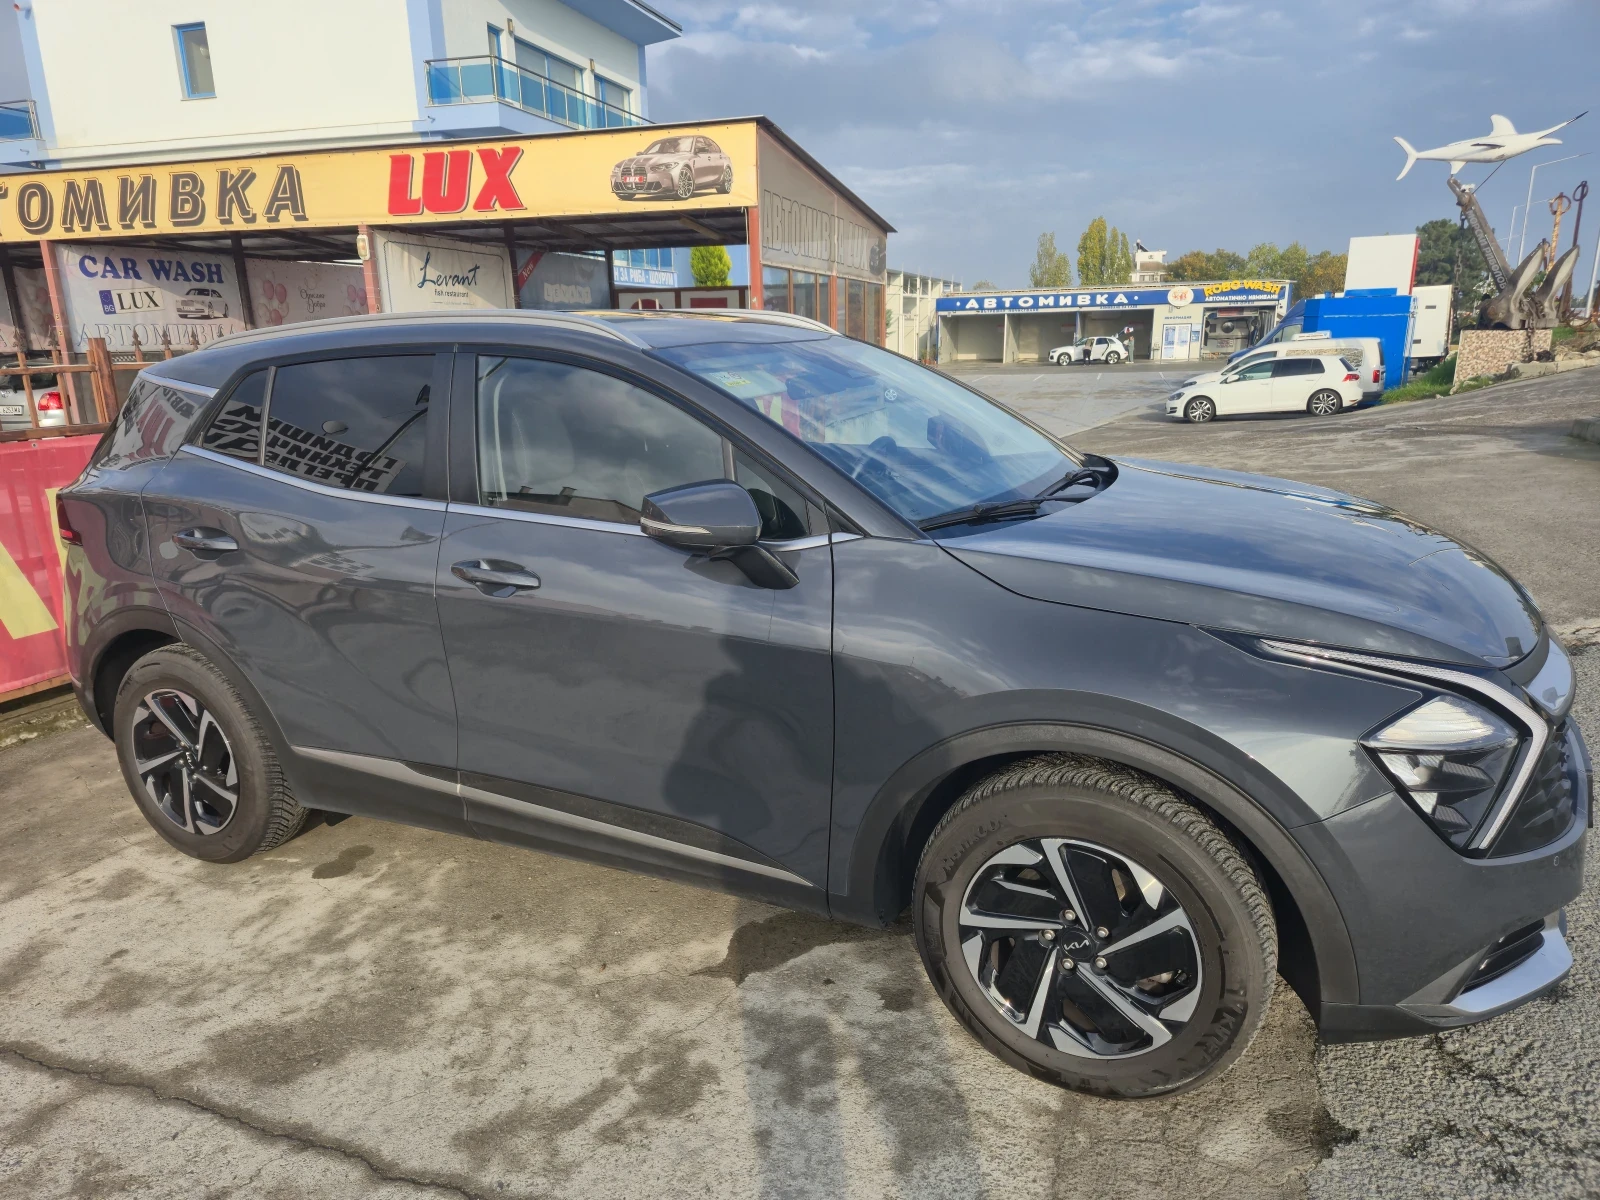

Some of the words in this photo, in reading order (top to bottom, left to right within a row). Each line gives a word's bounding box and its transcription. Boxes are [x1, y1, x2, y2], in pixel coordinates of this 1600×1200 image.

[388, 146, 527, 216] LUX
[79, 255, 142, 280] CAR
[147, 259, 224, 284] WASH
[417, 251, 480, 288] Levant
[522, 262, 534, 280] New
[1483, 247, 1507, 290] РИБОЛОВ
[546, 288, 590, 298] LEVANT
[1203, 280, 1240, 297] ROBO
[1243, 279, 1282, 295] WASH
[104, 304, 115, 312] BG
[116, 290, 161, 310] LUX
[965, 293, 1128, 309] АВТОМИВКА
[1064, 939, 1089, 951] KIA
